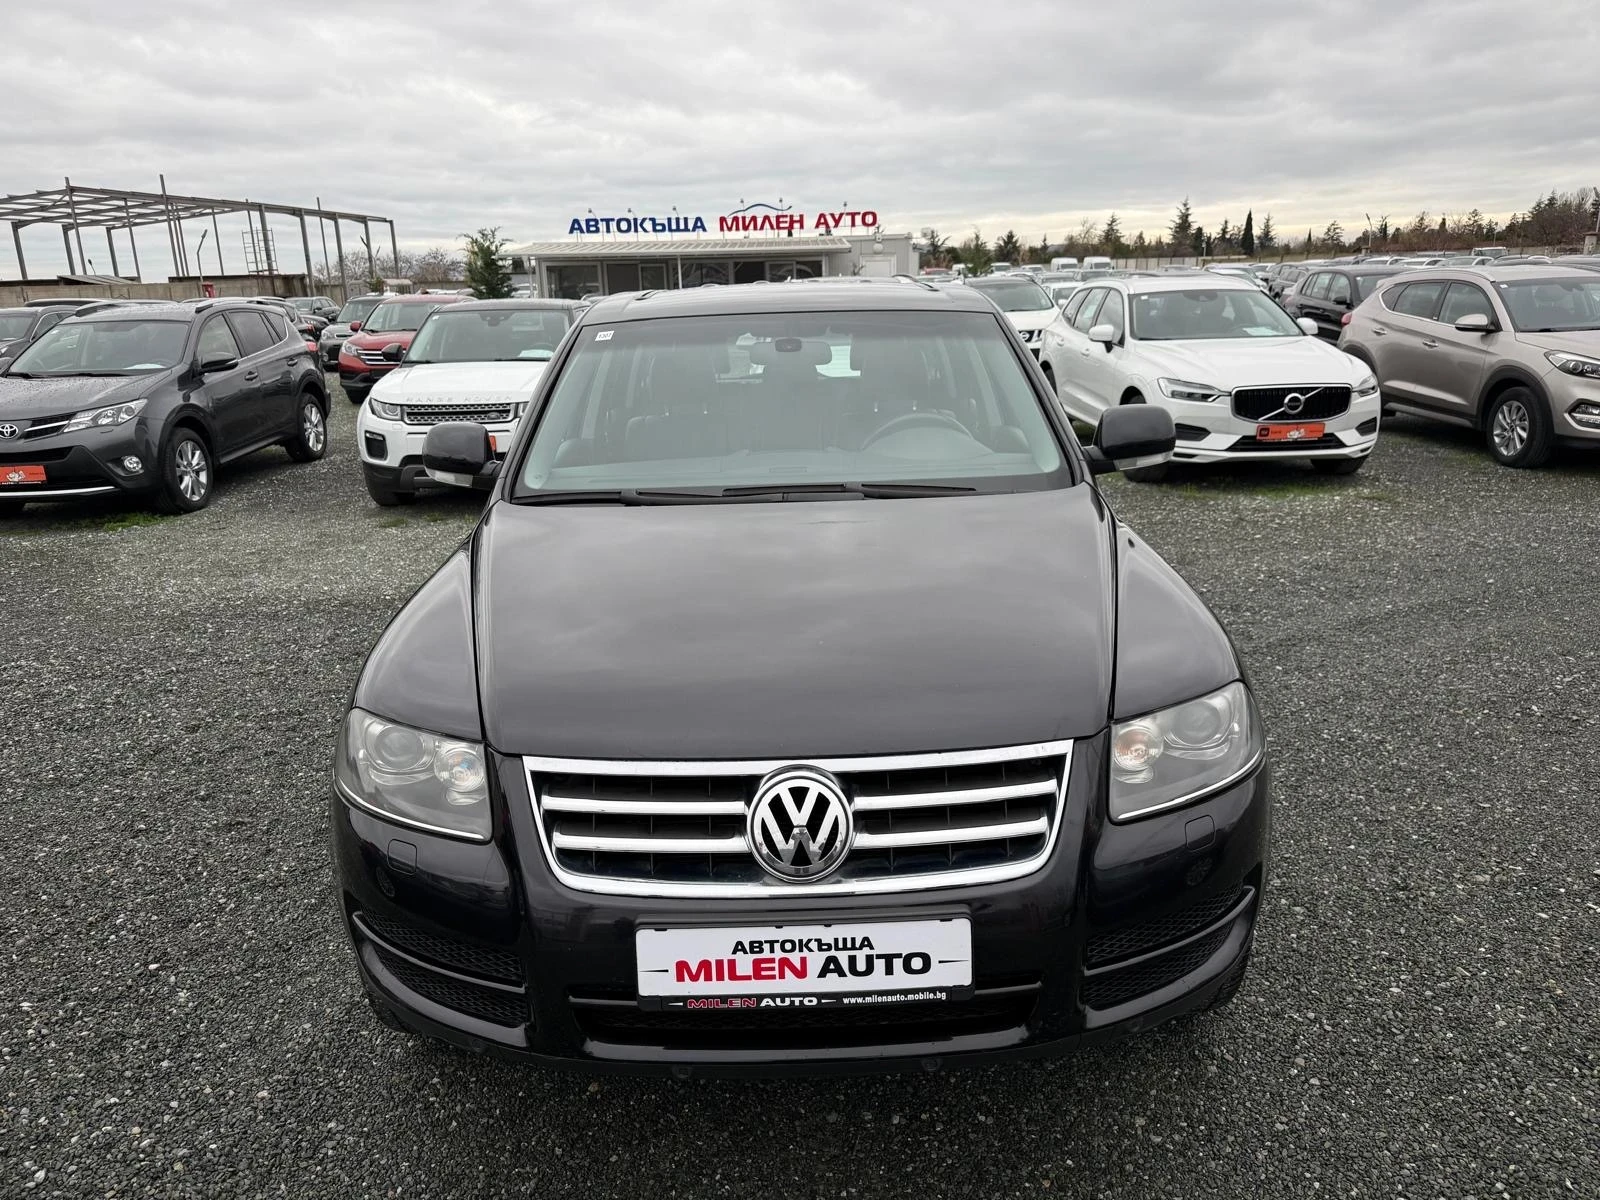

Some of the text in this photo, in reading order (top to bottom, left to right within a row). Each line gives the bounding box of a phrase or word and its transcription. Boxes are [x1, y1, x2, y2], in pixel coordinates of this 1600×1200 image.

[719, 214, 804, 232] МИЛЕН
[815, 211, 877, 229] АУТО
[675, 952, 932, 982] MILEN AUTO
[687, 997, 818, 1009] MILEN AUTO
[842, 991, 947, 1004] www.milenauto.mobile.bg
